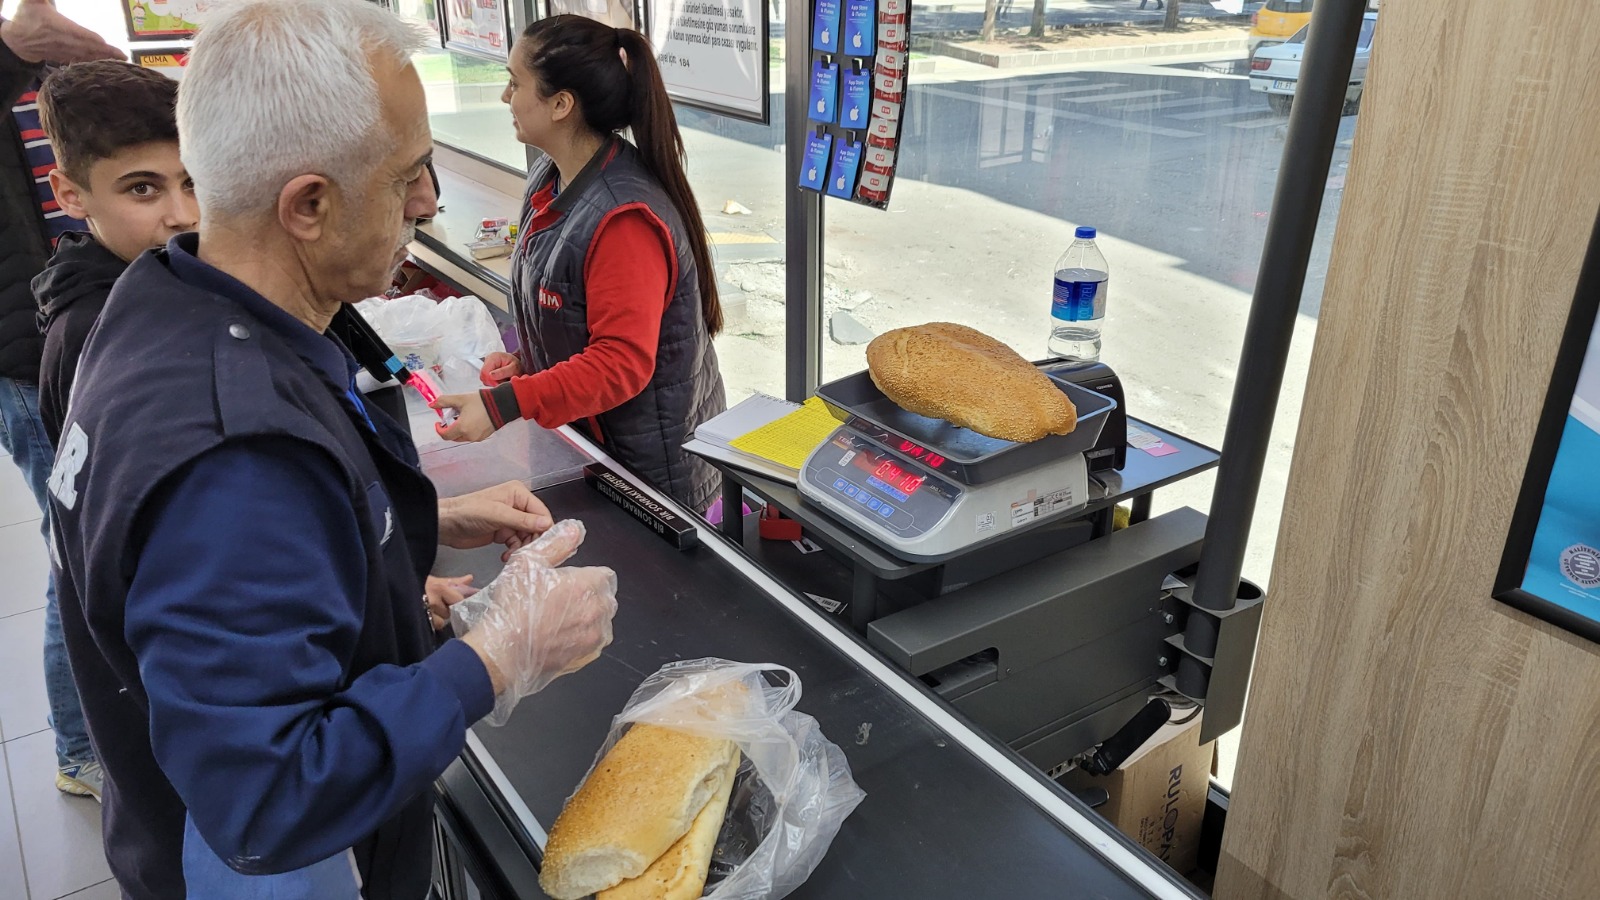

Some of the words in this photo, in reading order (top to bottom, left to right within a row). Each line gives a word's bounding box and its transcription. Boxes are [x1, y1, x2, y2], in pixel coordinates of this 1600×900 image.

[680, 58, 690, 67] 184
[600, 472, 632, 492] MÜŞTERİ
[626, 490, 662, 512] SONRAKİ
[622, 498, 652, 526] SONRAKİ
[660, 510, 676, 521] BİR
[654, 519, 664, 534] BİR
